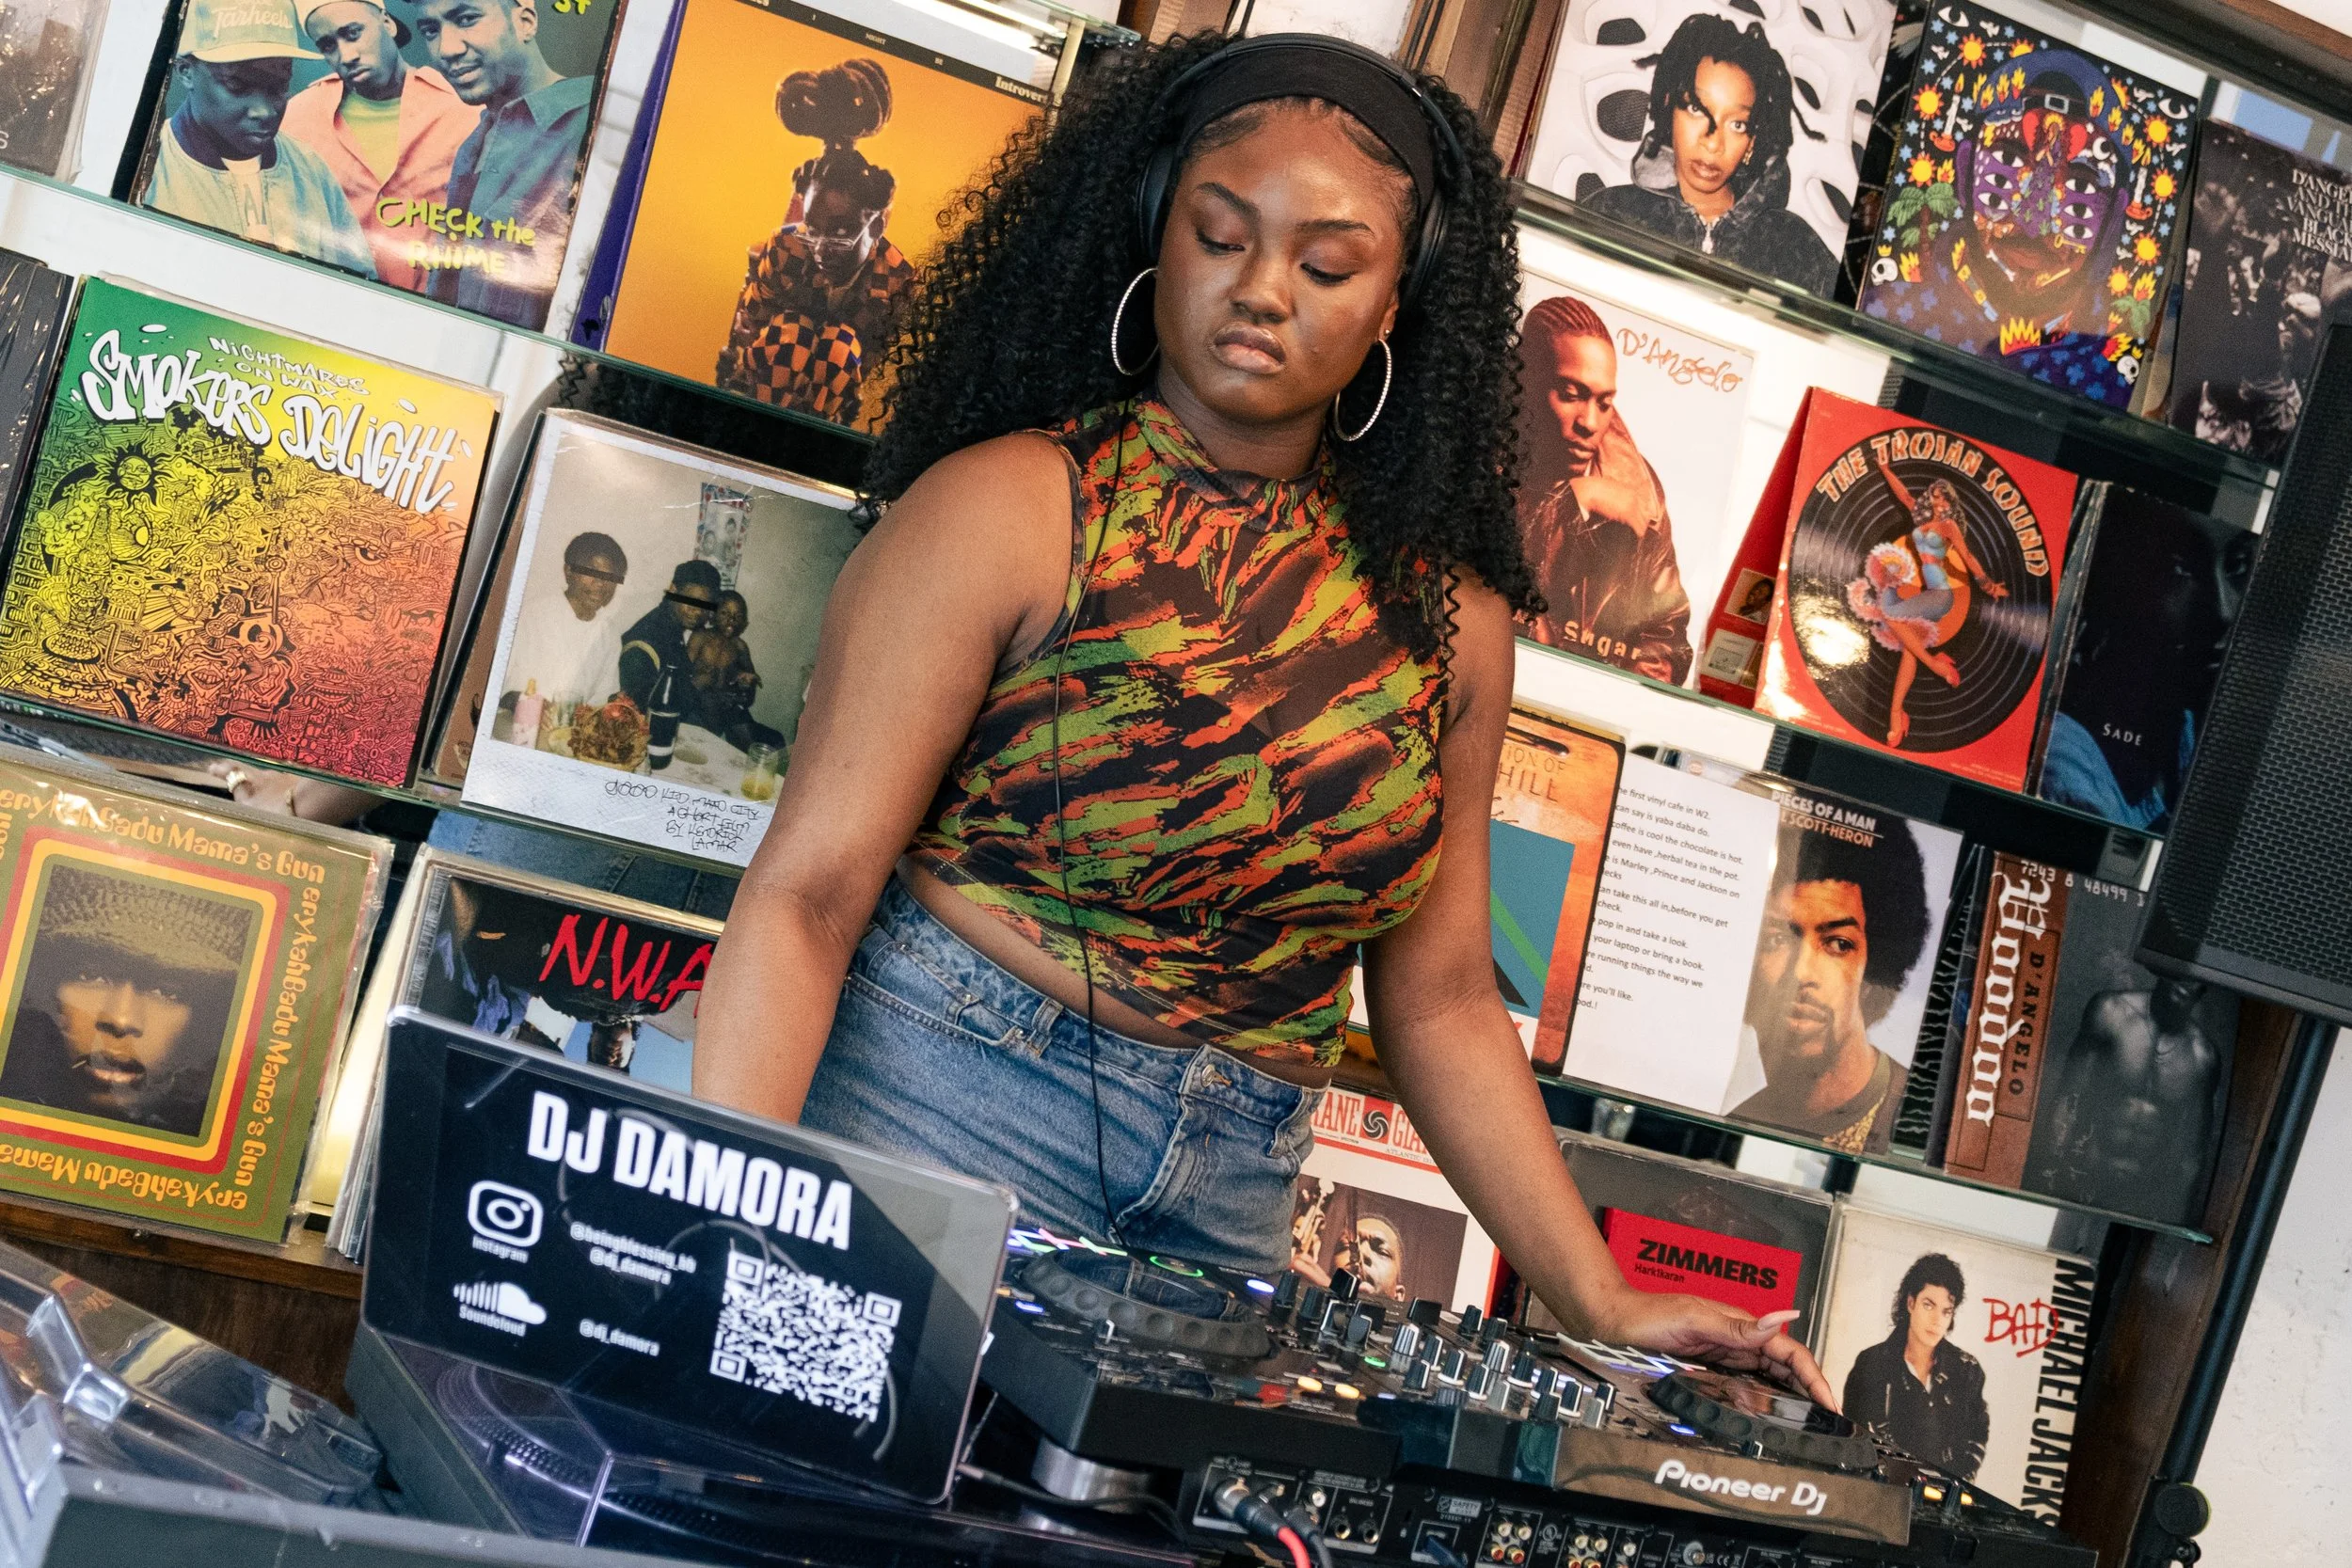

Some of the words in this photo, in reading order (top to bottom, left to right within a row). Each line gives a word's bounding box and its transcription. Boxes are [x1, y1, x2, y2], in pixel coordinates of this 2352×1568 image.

[2295, 186, 2330, 210] AND
[377, 198, 485, 239] CHECK
[491, 217, 536, 246] the
[234, 362, 275, 383] ON
[280, 373, 338, 401] WAX
[1816, 447, 1868, 502] THE
[1870, 429, 1984, 478] TROJAN
[1981, 467, 2049, 578] SOUND
[1563, 620, 1641, 661] Sugar
[2103, 722, 2142, 746] SADE
[1629, 789, 1645, 800] first
[1647, 796, 1665, 806] vinyl
[1668, 802, 1684, 811] cafe
[1772, 790, 1814, 815] PIECES
[1815, 803, 1834, 818] OF
[1832, 809, 1844, 823] A
[1845, 813, 1876, 832] MAN
[1631, 810, 1645, 818] say
[1656, 816, 1674, 826] yaba
[1677, 822, 1695, 832] daba
[1697, 828, 1710, 836] do.
[1788, 812, 1874, 847] SCOTT-HERON
[169, 822, 273, 872] Mama's
[276, 849, 326, 884] Gun
[1613, 840, 1631, 850] even
[1633, 844, 1652, 856] have
[1685, 860, 1697, 868] tea
[1709, 866, 1722, 875] the
[1724, 872, 1739, 880] pot.
[1646, 832, 1663, 841] cool
[1665, 836, 1678, 845] the
[1680, 841, 1718, 857] chocolate
[1728, 854, 1743, 864] hot.
[1621, 858, 1649, 873] Marley
[1697, 880, 1727, 894] Jackson
[2021, 860, 2056, 882] 7243
[2064, 871, 2074, 887] 8
[2084, 878, 2128, 903] 48499
[1613, 890, 1629, 900] take
[1633, 895, 1646, 904] this
[1699, 914, 1713, 923] you
[1594, 935, 1613, 944] your
[1614, 939, 1640, 954] laptop
[1653, 950, 1673, 963] bring
[1682, 958, 1704, 971] book.
[1597, 919, 1613, 928] pop
[1626, 927, 1641, 935] and
[1643, 930, 1660, 941] take
[1669, 937, 1688, 948] look.
[1597, 955, 1629, 969] running
[1631, 963, 1655, 975] things
[1658, 970, 1671, 979] the
[1673, 975, 1690, 986] way
[1617, 990, 1633, 1001] like.
[2009, 951, 2045, 1096] D'ANGELO
[247, 1038, 292, 1137] Mama's
[1311, 1091, 1360, 1136] ANE
[234, 1140, 267, 1187] Gun
[527, 1089, 608, 1174] DJ
[613, 1117, 852, 1250] DAMORA
[472, 1234, 529, 1264] Instagram
[590, 1246, 672, 1286] @dj_damora
[1637, 1238, 1778, 1290] ZIMMERS
[459, 1304, 527, 1338] Soundcloud
[580, 1318, 660, 1356] @dj_damora
[1982, 1296, 2059, 1357] BAD
[2035, 1259, 2096, 1414] MICHAEL
[1654, 1459, 1786, 1503] Pioneer
